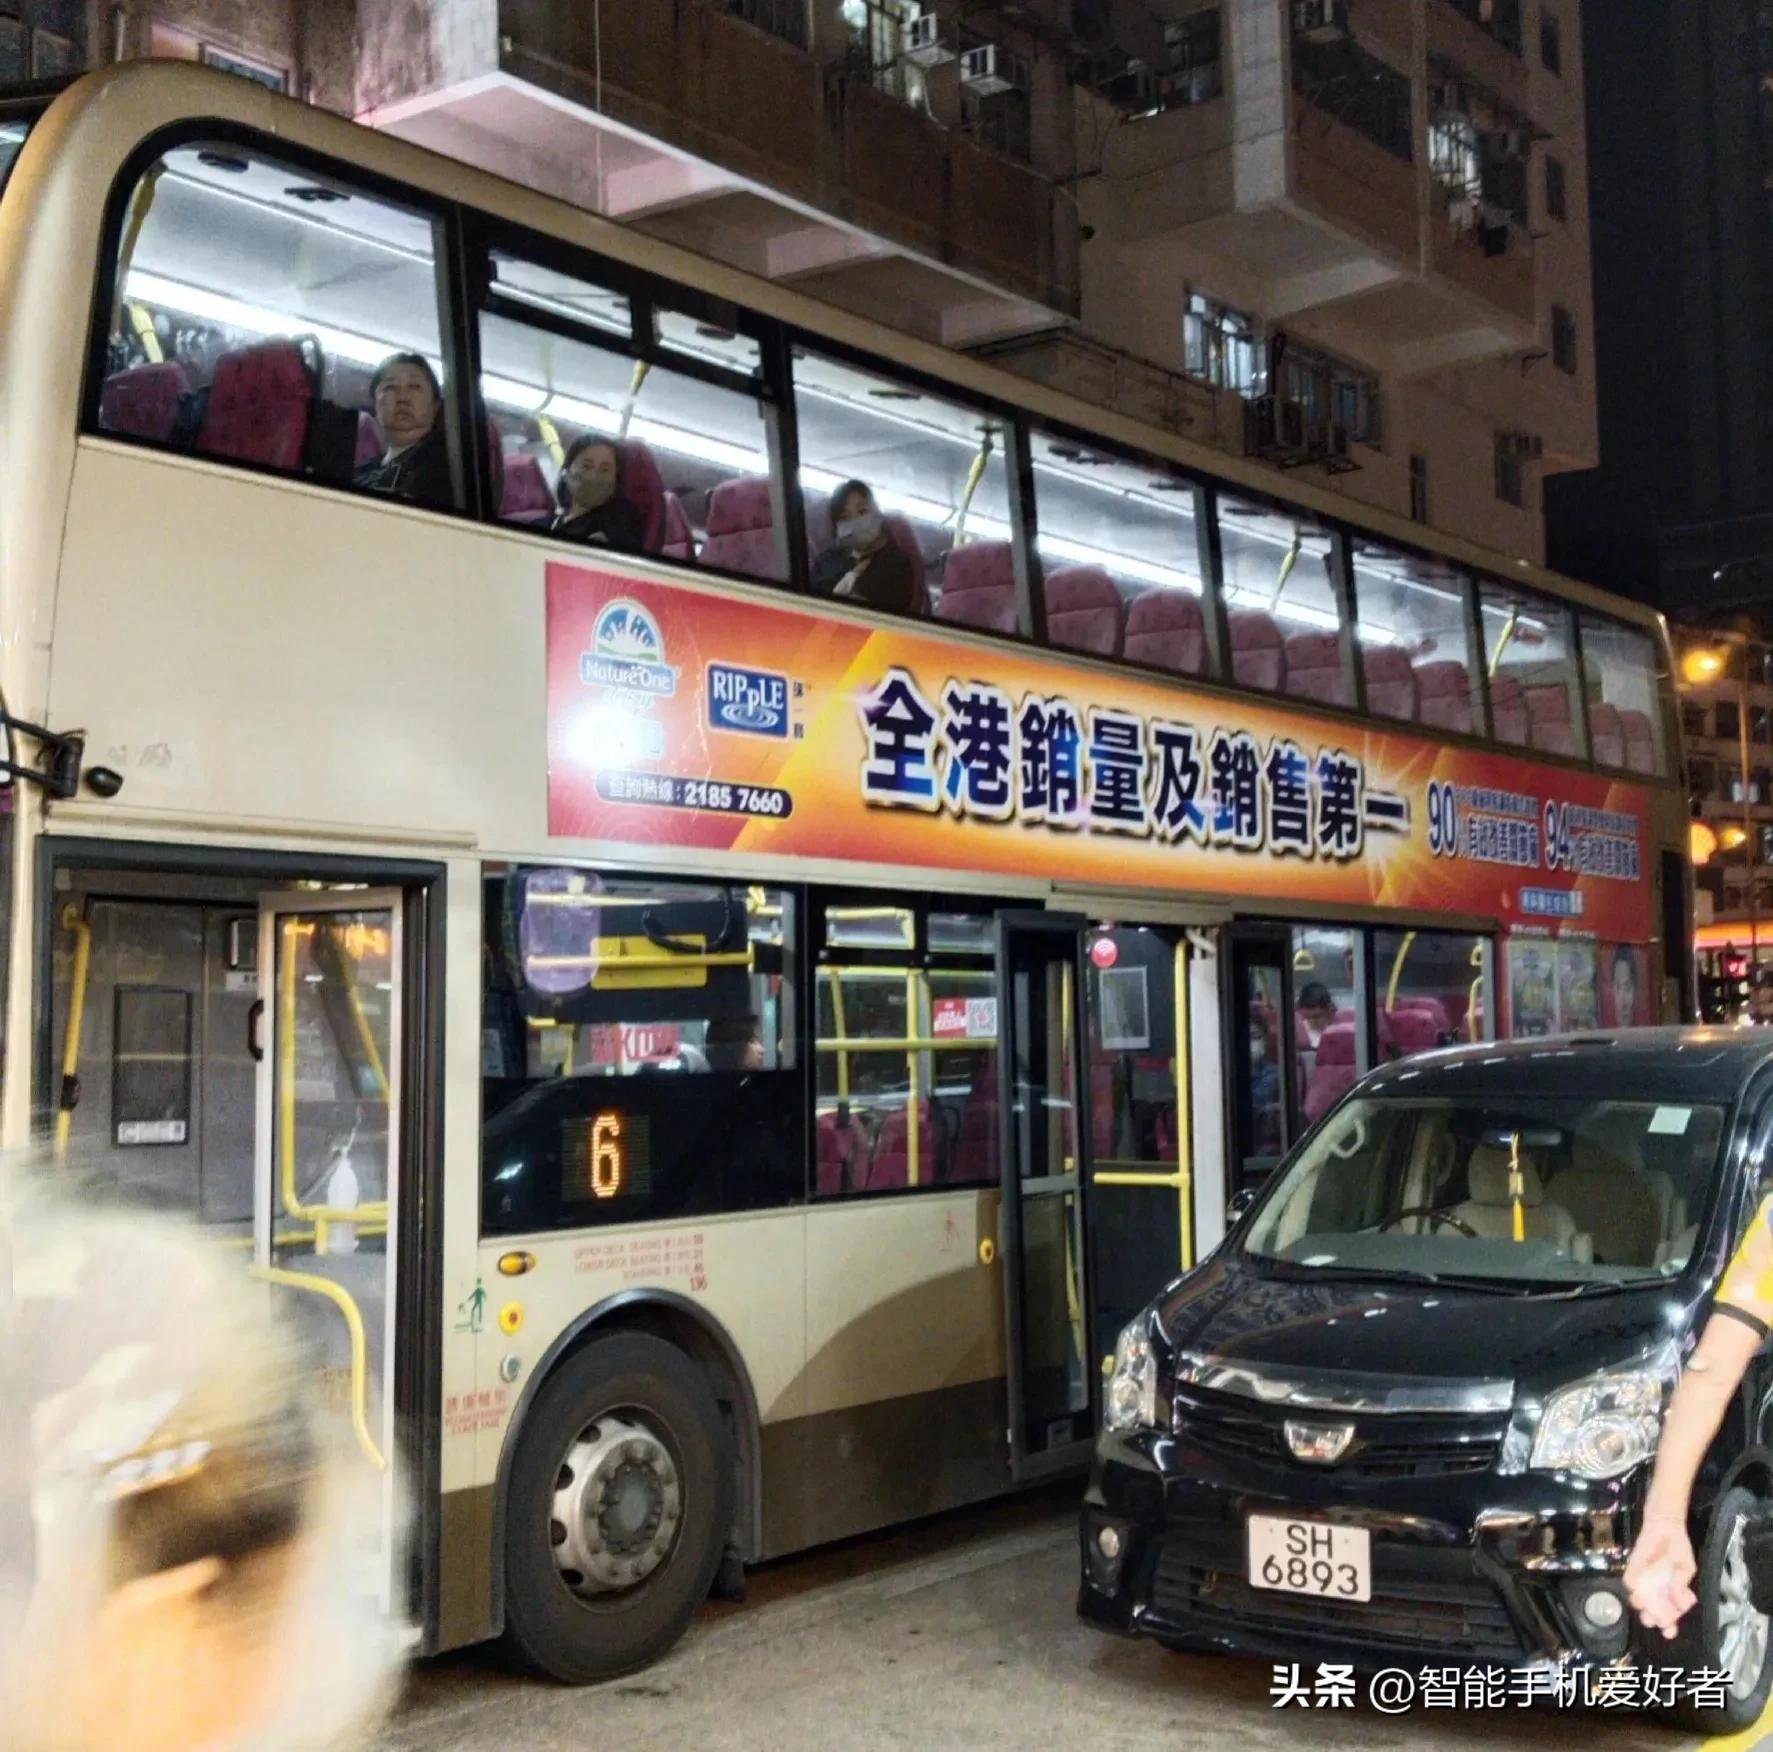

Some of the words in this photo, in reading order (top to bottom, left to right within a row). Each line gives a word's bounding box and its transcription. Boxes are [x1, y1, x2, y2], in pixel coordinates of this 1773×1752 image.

[861, 667, 1409, 863] 全港銷量及銷售第一
[684, 781, 732, 809] 2185
[737, 788, 784, 814] 7660
[592, 1115, 619, 1198] 6
[1286, 1524, 1333, 1559] SH
[1262, 1554, 1359, 1596] 6893
